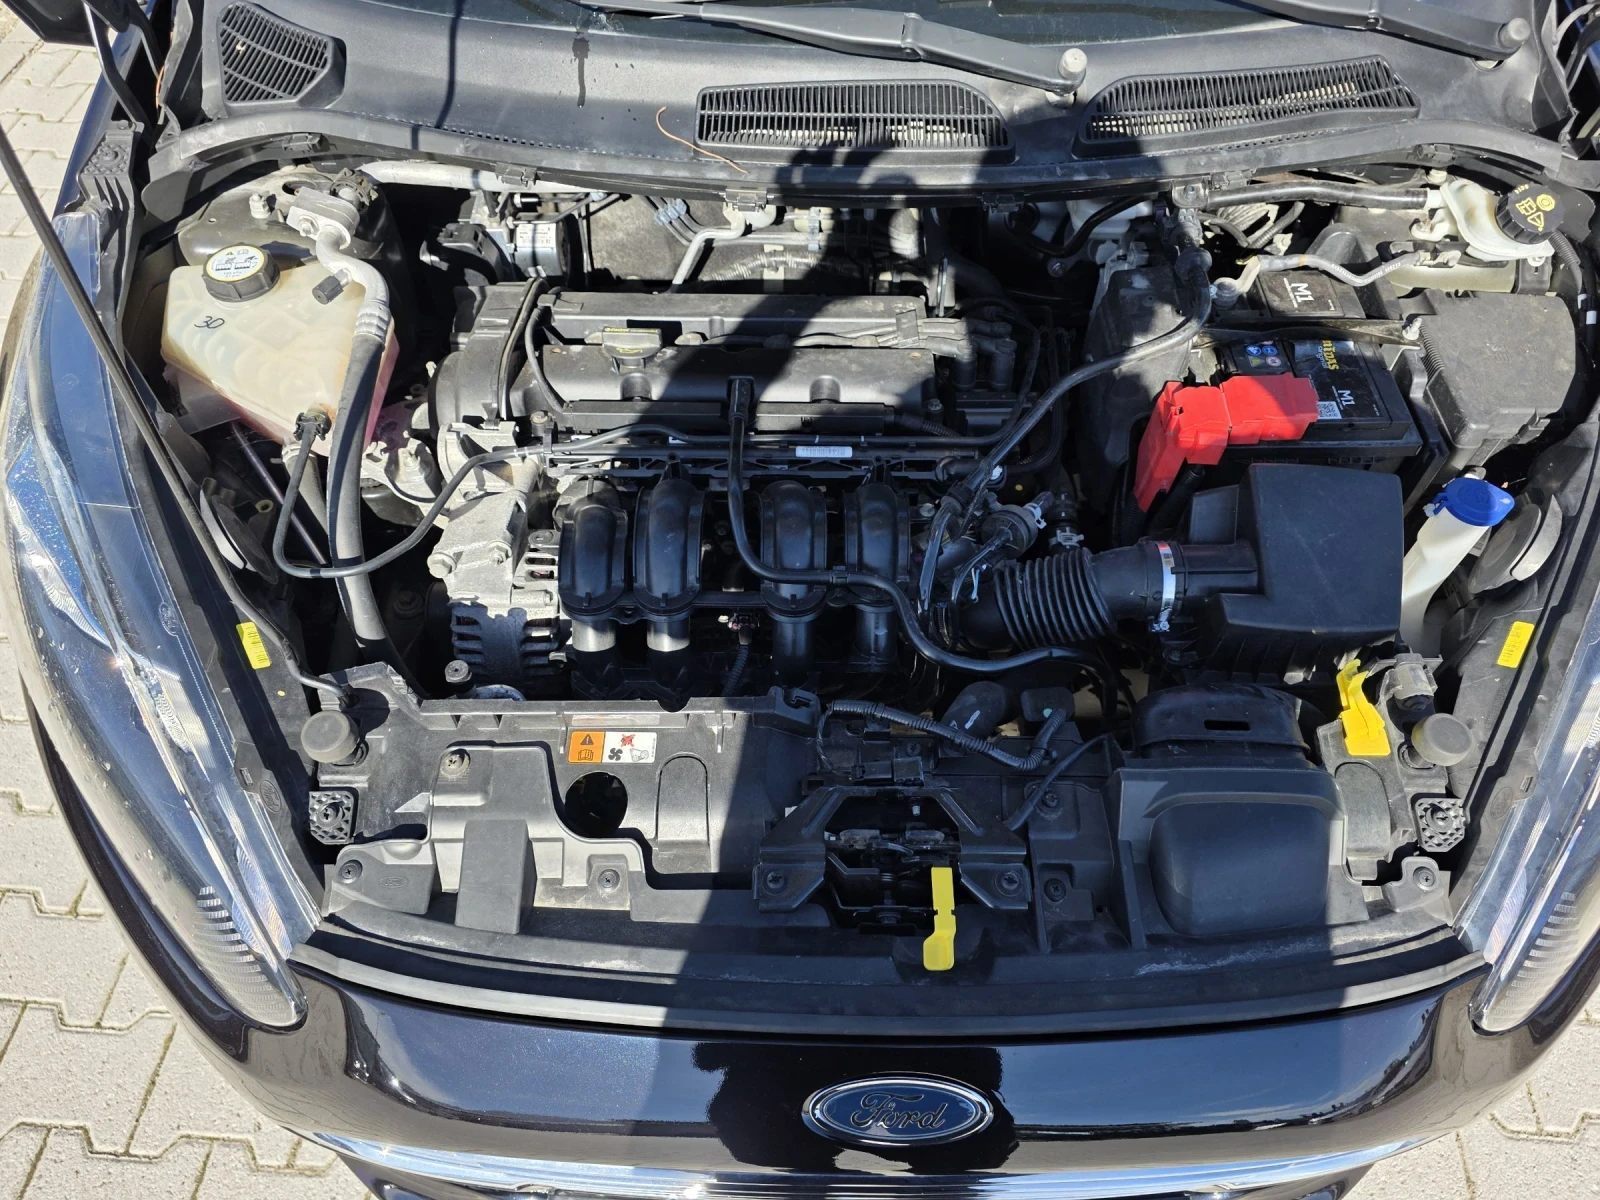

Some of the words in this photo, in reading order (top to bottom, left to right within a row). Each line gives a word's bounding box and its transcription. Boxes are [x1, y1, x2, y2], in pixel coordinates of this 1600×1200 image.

[1290, 282, 1314, 302] M1
[193, 315, 226, 329] 30
[1337, 390, 1356, 406] M1
[850, 1091, 949, 1129] Ford
